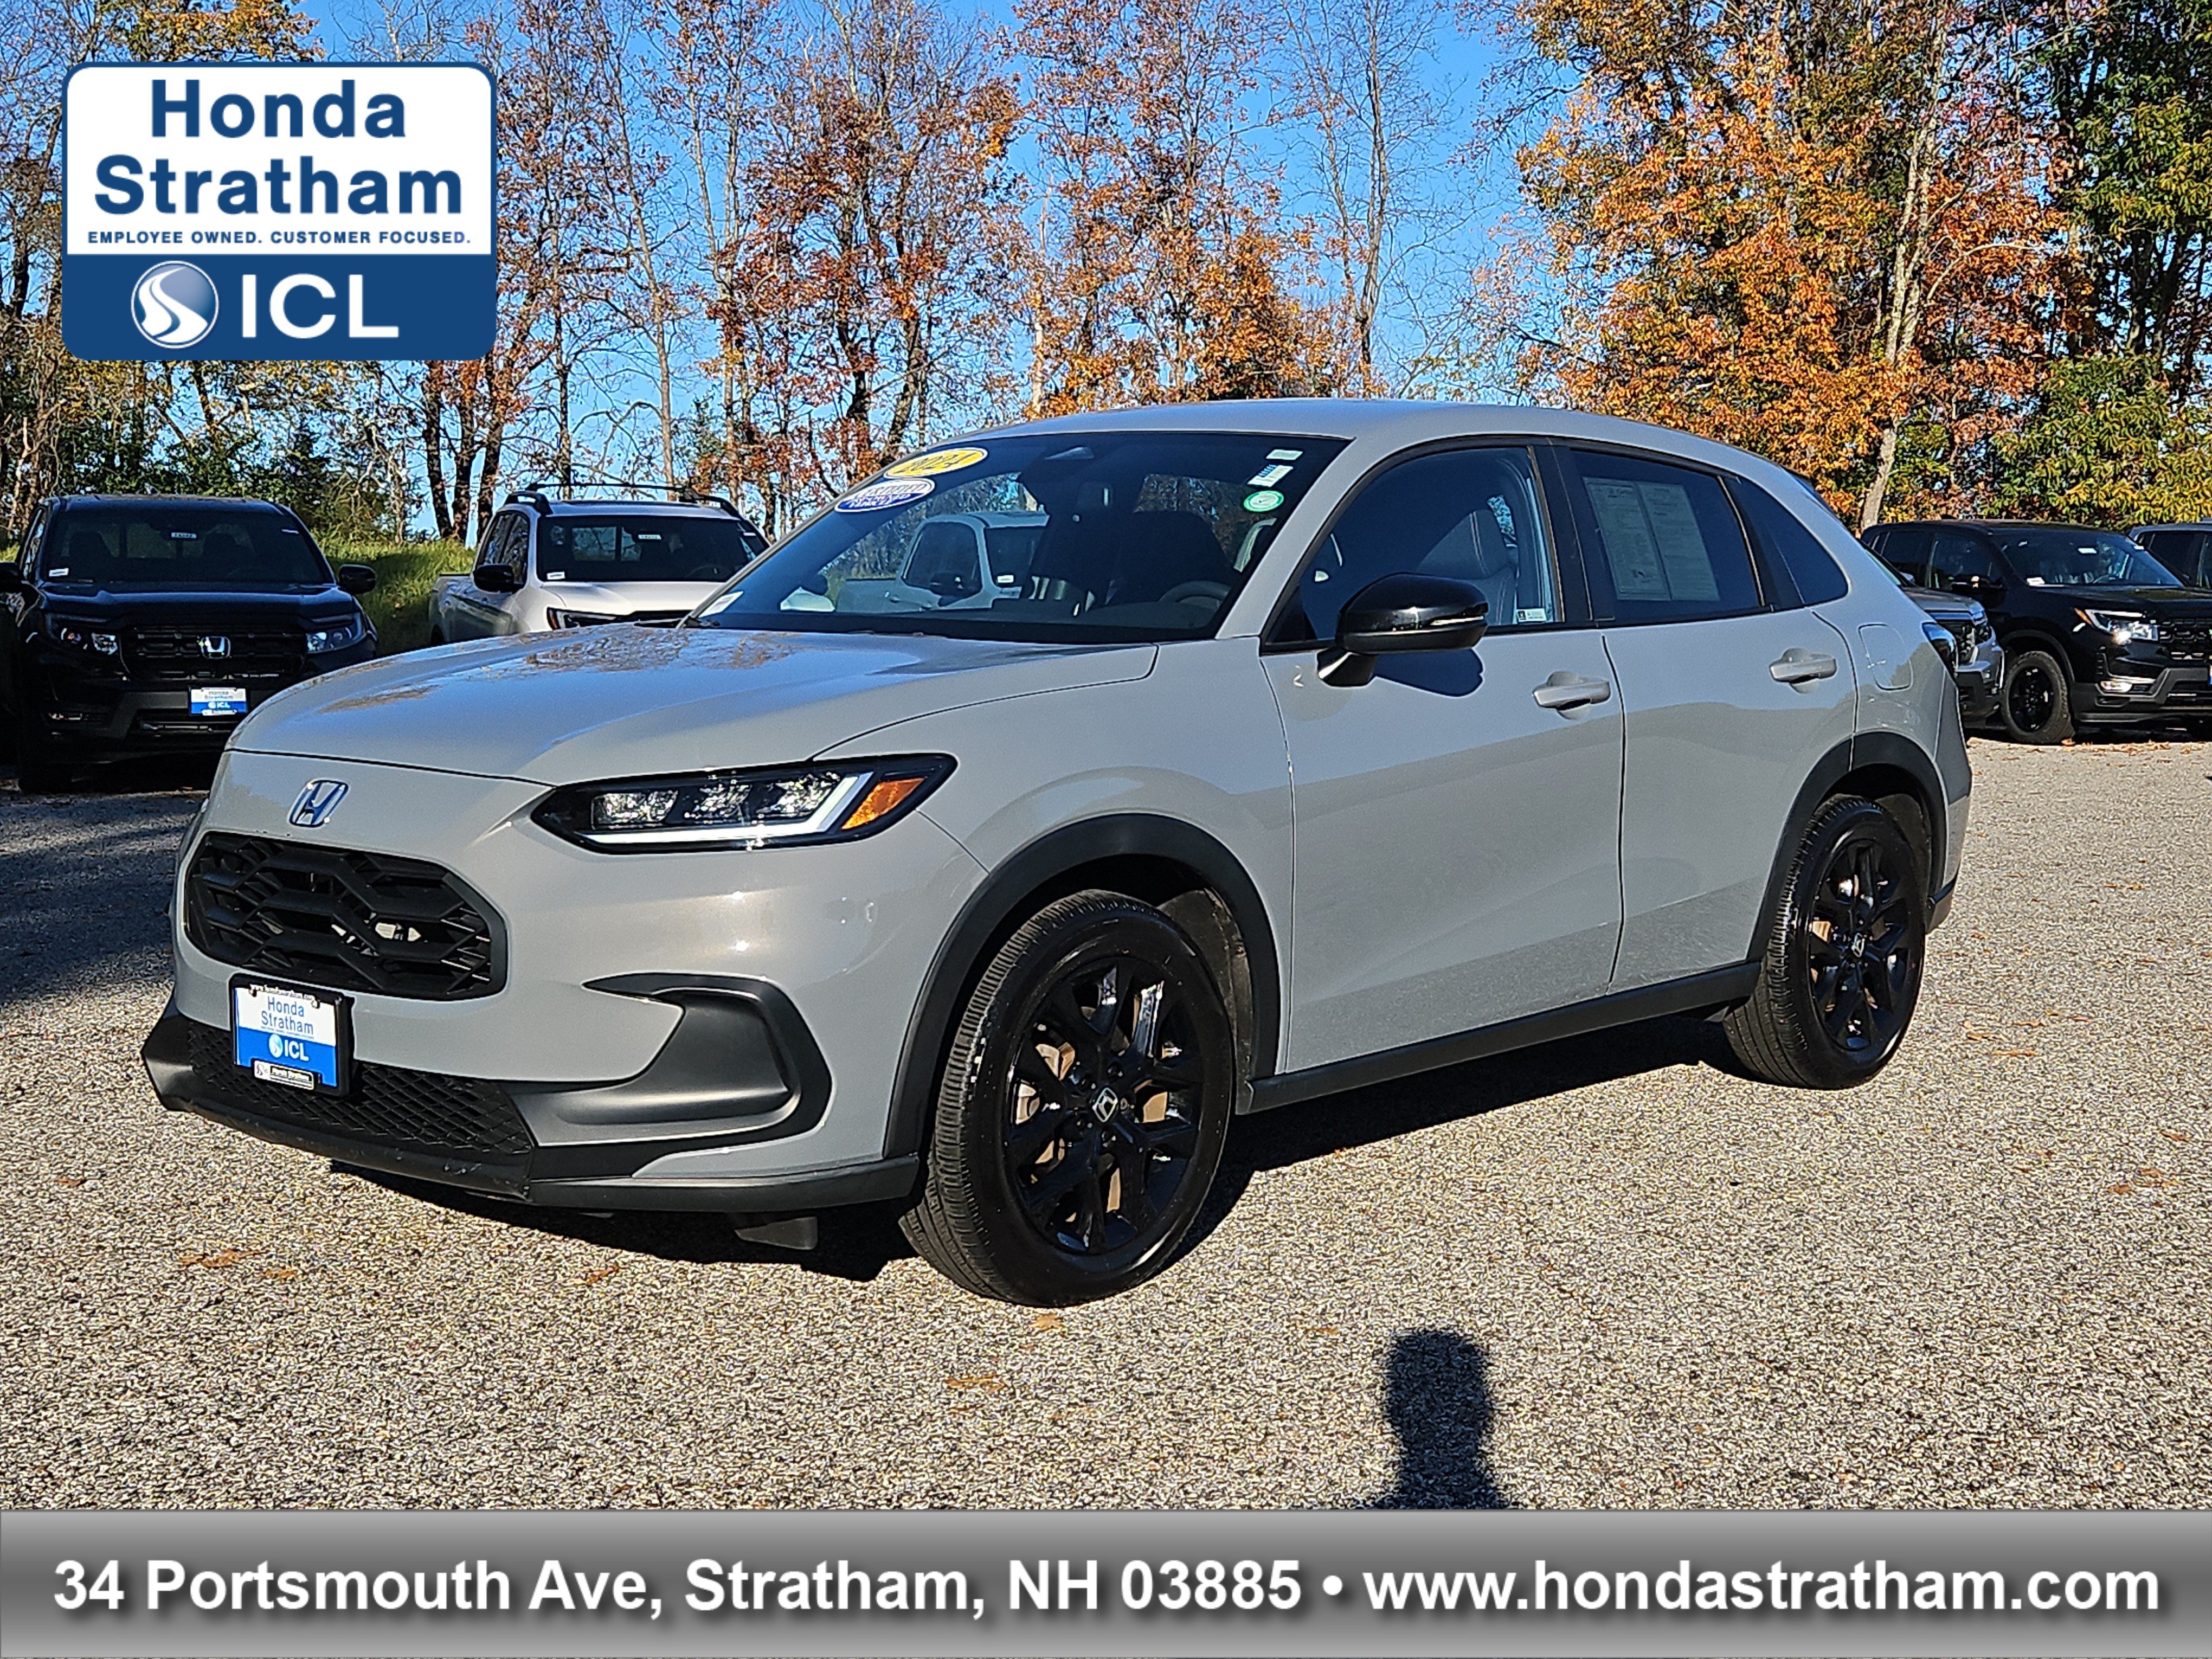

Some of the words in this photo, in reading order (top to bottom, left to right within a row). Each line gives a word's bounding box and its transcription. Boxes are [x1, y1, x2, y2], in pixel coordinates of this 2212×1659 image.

[267, 996, 305, 1018] Honda
[261, 1011, 314, 1036] Stratham
[284, 1039, 310, 1062] ICL
